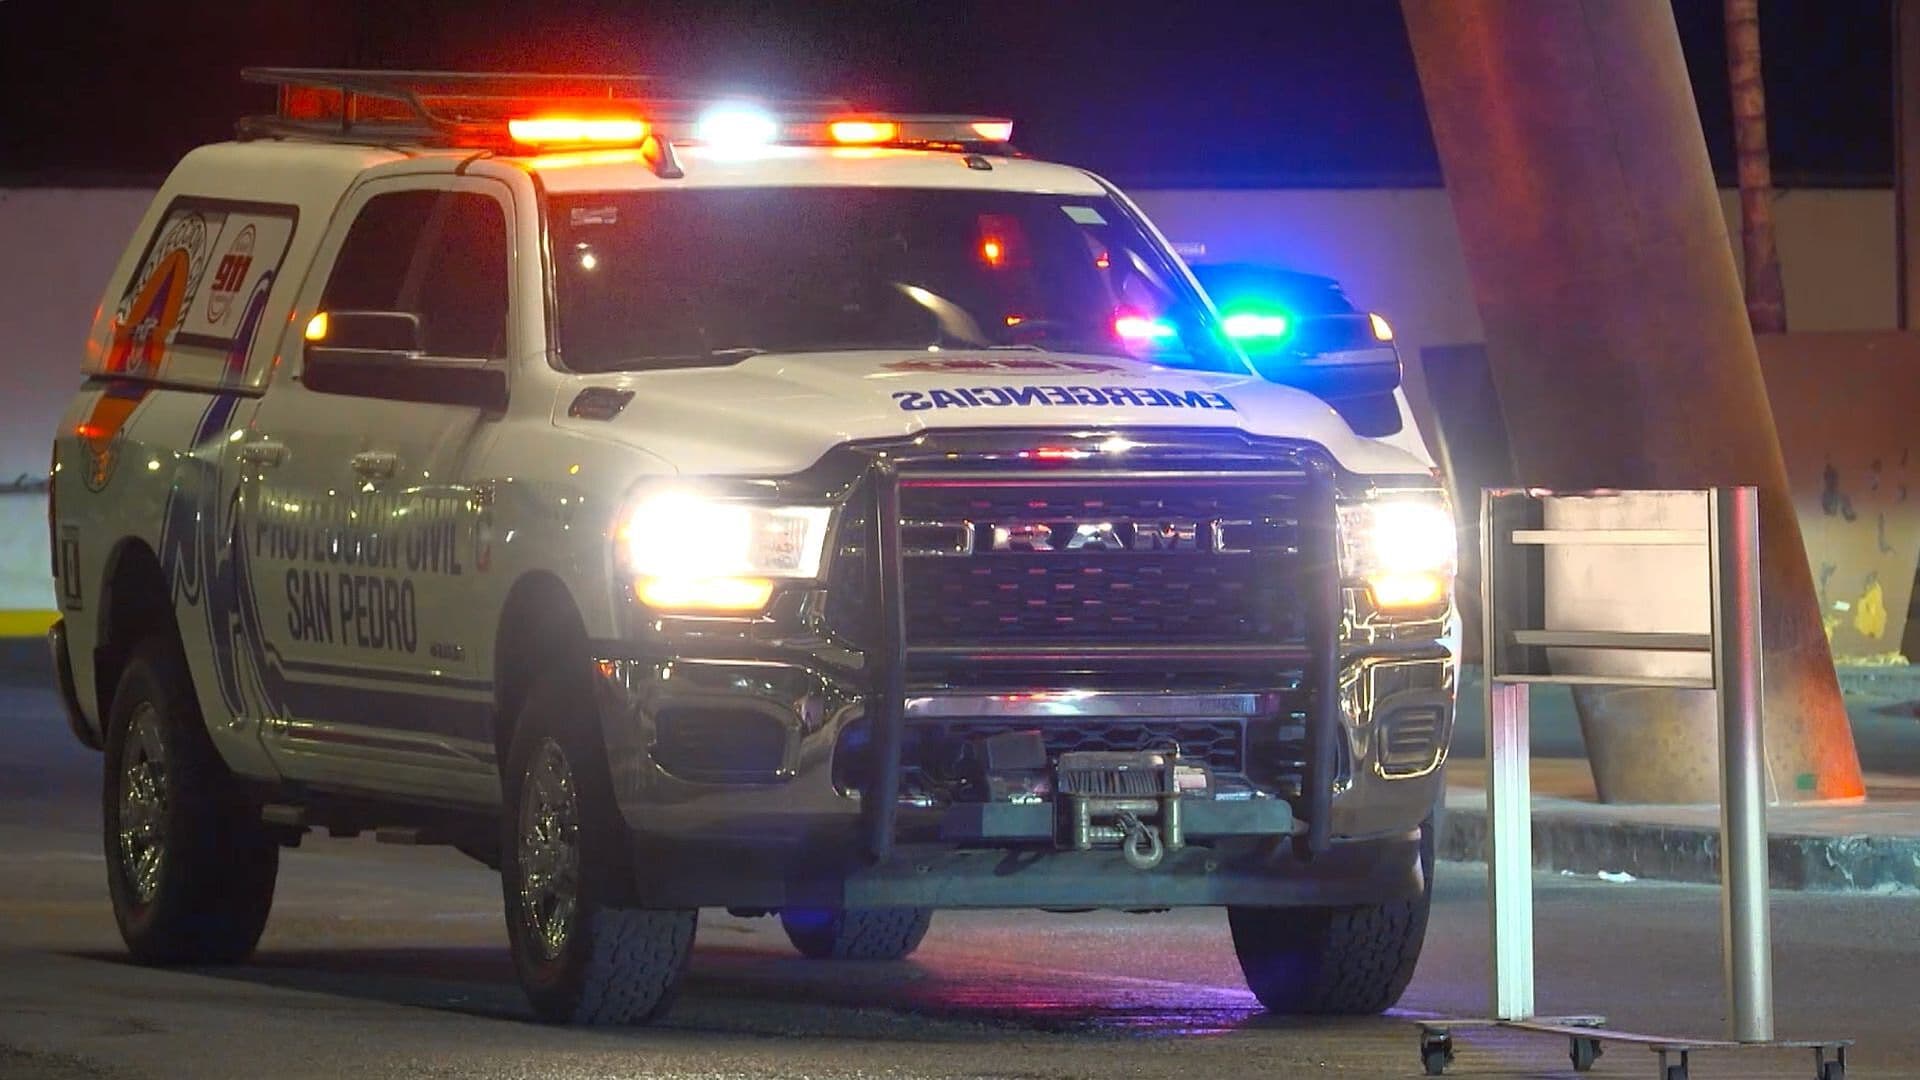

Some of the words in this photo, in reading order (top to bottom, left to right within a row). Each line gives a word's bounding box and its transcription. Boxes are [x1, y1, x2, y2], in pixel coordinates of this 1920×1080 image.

[991, 521, 1197, 551] RAM
[286, 567, 334, 644] SAN
[338, 572, 417, 653] PEDRO
